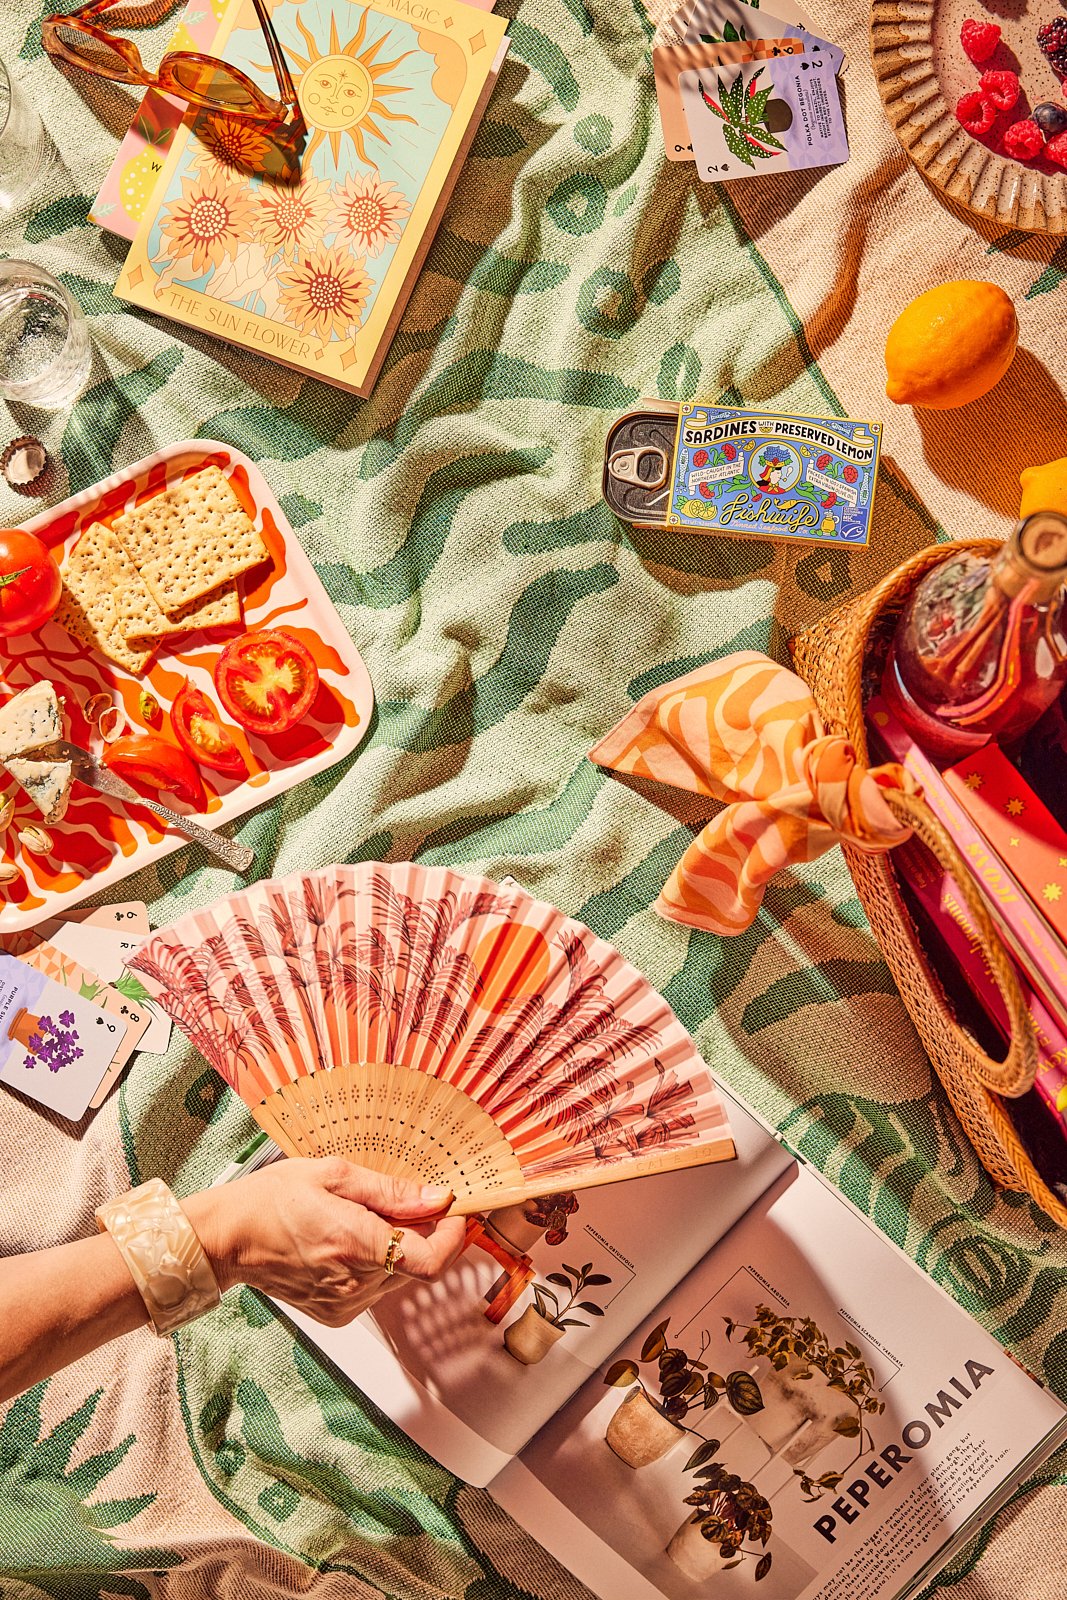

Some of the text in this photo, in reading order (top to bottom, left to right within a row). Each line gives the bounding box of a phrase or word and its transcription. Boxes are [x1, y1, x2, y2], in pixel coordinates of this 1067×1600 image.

[811, 60, 823, 69] 2
[794, 75, 804, 105] BEGONIA
[674, 144, 685, 153] 9
[804, 123, 812, 145] POLKA
[707, 164, 719, 173] 2
[169, 291, 311, 359] THE SUN FLOWER
[685, 420, 873, 460] SARDINES WITH PRESERVED LEMON
[719, 493, 819, 533] Fishwife
[3, 986, 18, 1010] PURPLE
[106, 1023, 116, 1033] 9
[129, 1012, 140, 1023] 8
[585, 1223, 610, 1246] PEPEROMIA
[746, 1264, 771, 1287] PEPEROMIA
[839, 1307, 861, 1328] PEPEROMIA
[812, 1359, 994, 1543] PEPEROMIA
[822, 1577, 836, 1592] may
[834, 1566, 845, 1577] not
[844, 1556, 853, 1566] be
[852, 1545, 864, 1557] the
[862, 1524, 885, 1547] biggest
[883, 1497, 909, 1525] members
[907, 1489, 916, 1499] of
[916, 1476, 931, 1491] your
[928, 1459, 946, 1477] plant
[959, 1431, 971, 1443] but
[822, 1440, 974, 1600] definitely make up for in fabulous foliage. Although they
[843, 1572, 860, 1589] these
[859, 1557, 874, 1573] little
[873, 1541, 890, 1559] plant
[927, 1487, 939, 1500] will
[938, 1467, 960, 1490] delight
[958, 1453, 972, 1467] with
[971, 1438, 986, 1454] their
[869, 1555, 897, 1584] cocktails,
[896, 1548, 904, 1556] to
[903, 1536, 914, 1548] the
[913, 1497, 953, 1538] swoon-worthy
[951, 1474, 973, 1498] trailing
[971, 1452, 994, 1476] Cupid's
[889, 1562, 900, 1573] it's
[900, 1548, 913, 1563] time
[913, 1541, 921, 1549] to
[920, 1530, 932, 1542] get
[931, 1522, 939, 1530] on
[937, 1503, 956, 1522] board
[955, 1492, 966, 1504] the
[965, 1462, 996, 1494] Peperomia
[993, 1446, 1010, 1463] train.
[844, 1589, 855, 1600] the
[853, 1558, 884, 1589] irresistible
[883, 1523, 916, 1558] Watermelon
[914, 1508, 932, 1525] plant
[930, 1475, 963, 1509] (Peperomia
